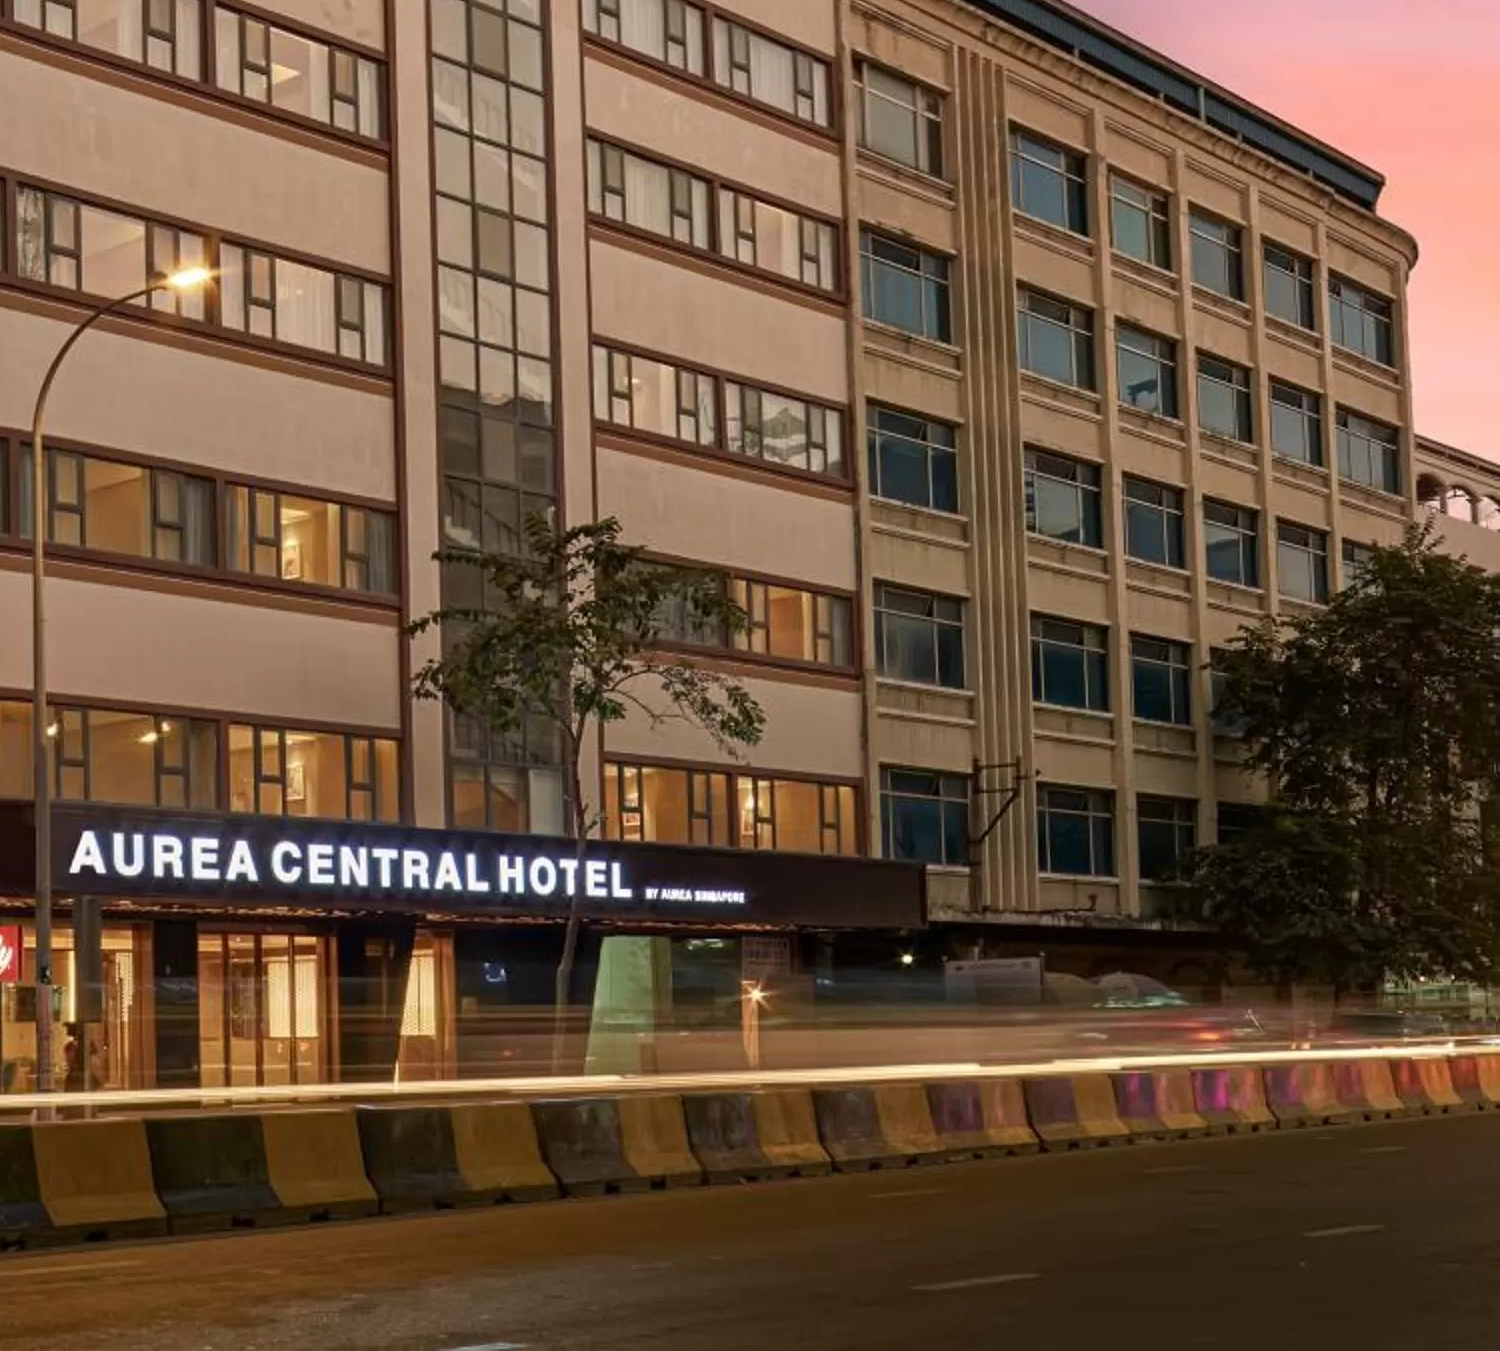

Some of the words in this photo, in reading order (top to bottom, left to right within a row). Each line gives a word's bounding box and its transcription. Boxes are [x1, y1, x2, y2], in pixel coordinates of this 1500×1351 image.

[68, 830, 259, 882] AUREA
[271, 840, 490, 892] CENTRAL
[498, 854, 633, 899] HOTEL
